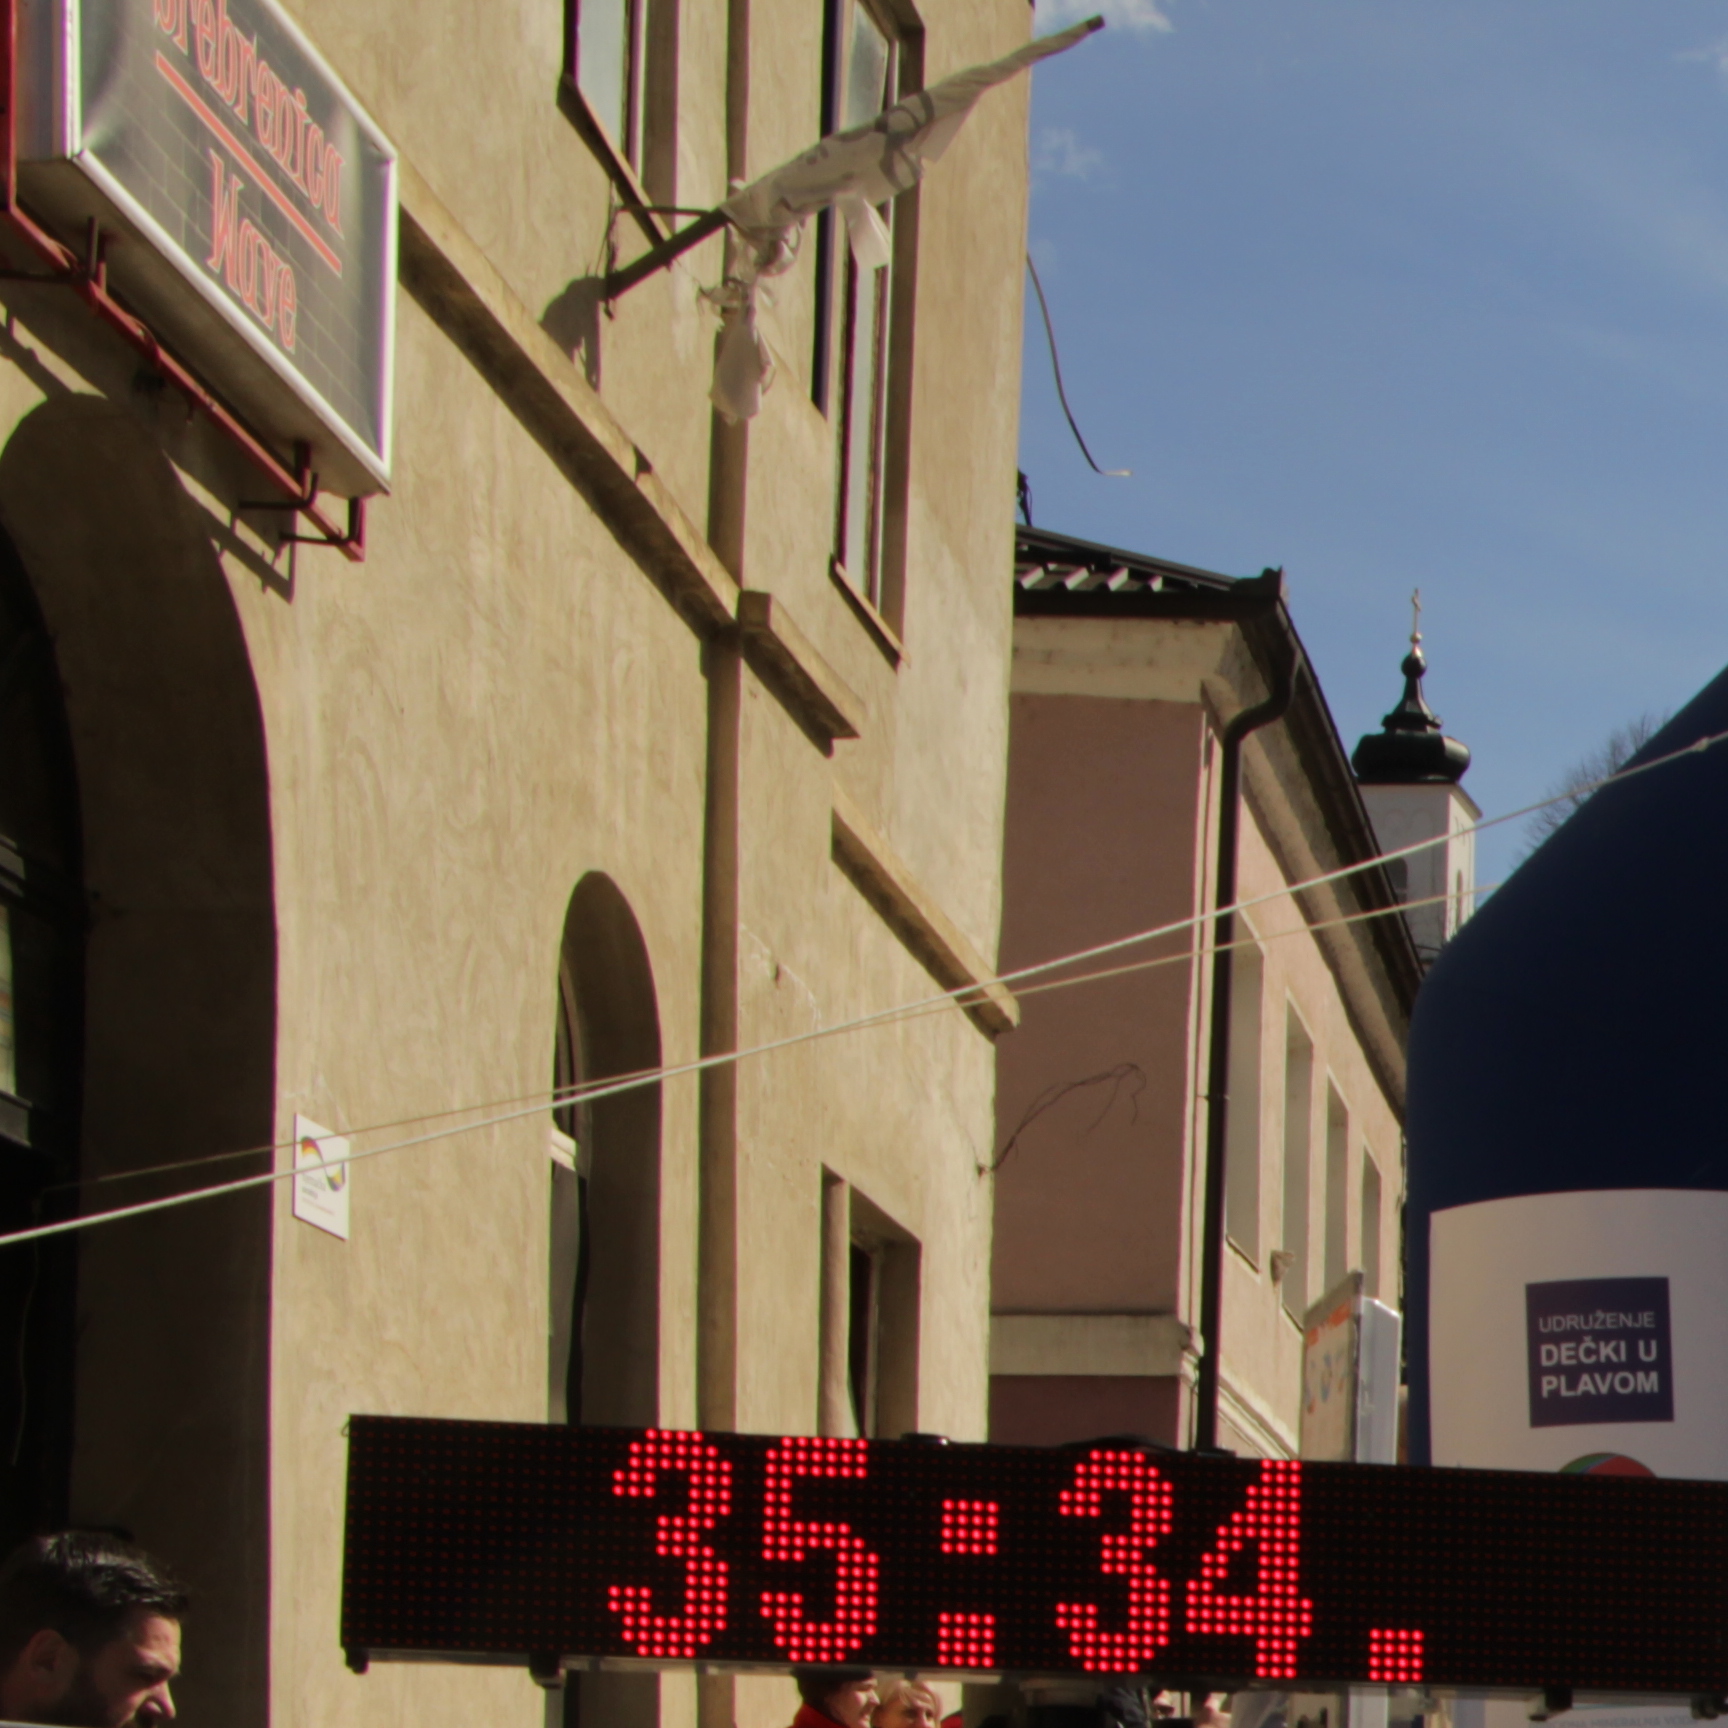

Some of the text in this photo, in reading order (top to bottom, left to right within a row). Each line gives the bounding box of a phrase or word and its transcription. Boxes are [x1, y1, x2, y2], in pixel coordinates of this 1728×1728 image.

[1538, 1310, 1655, 1333] UDRUŽENJE
[1540, 1335, 1657, 1367] DEČKI U
[1541, 1371, 1659, 1399] PLAVOM
